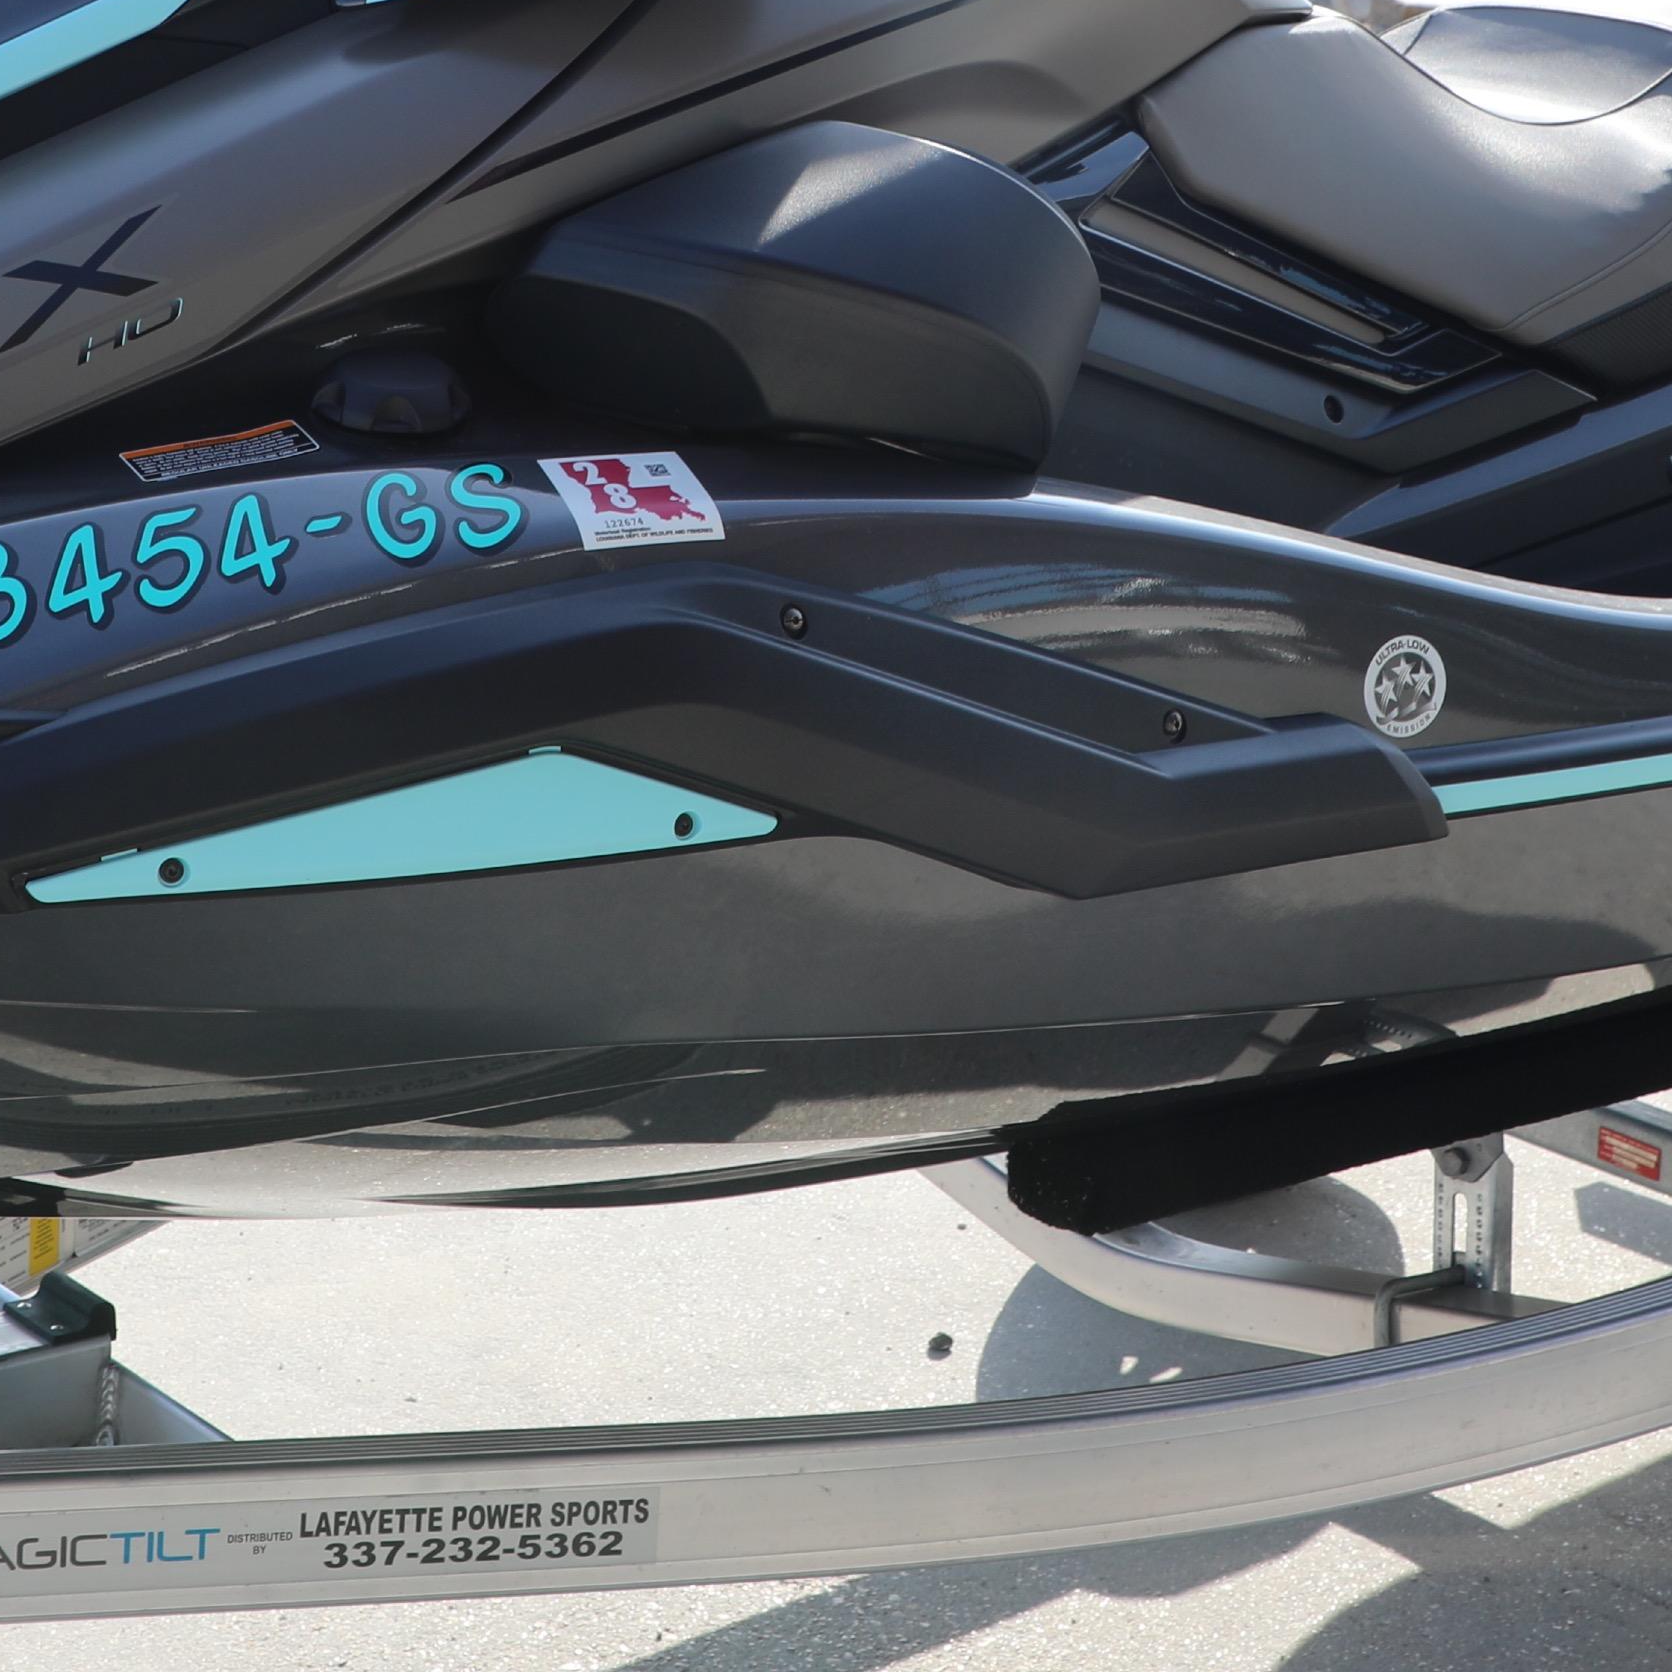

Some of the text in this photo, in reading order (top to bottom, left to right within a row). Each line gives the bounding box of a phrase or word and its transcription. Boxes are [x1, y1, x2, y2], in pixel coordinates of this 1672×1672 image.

[572, 461, 608, 486] 2
[603, 483, 637, 509] 8
[604, 517, 644, 529] 122674
[1375, 639, 1430, 666] ULTRA-LOW
[299, 1497, 650, 1538] LAFAYETTE POWER SPORTS
[227, 1531, 293, 1544] DISTRIBUTED
[252, 1544, 266, 1556] BY
[323, 1530, 624, 1568] 337-232-5362
